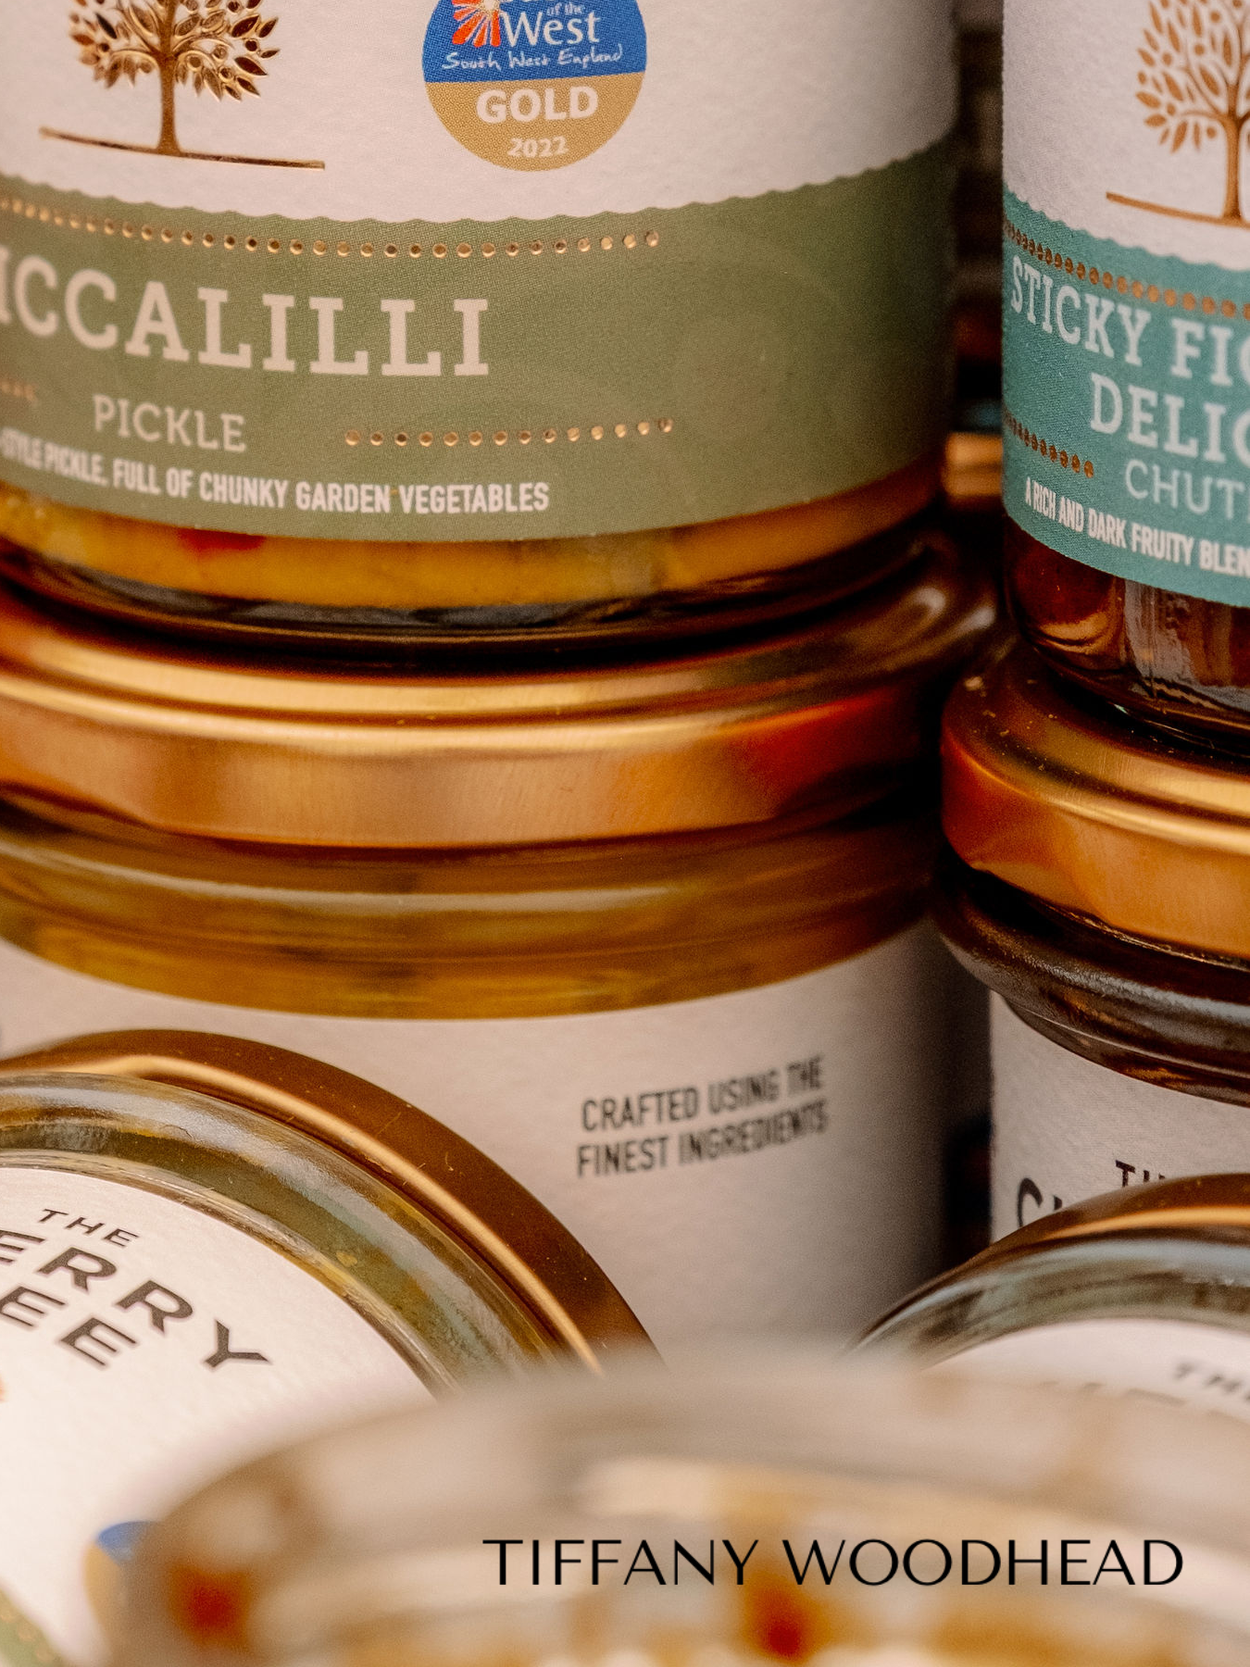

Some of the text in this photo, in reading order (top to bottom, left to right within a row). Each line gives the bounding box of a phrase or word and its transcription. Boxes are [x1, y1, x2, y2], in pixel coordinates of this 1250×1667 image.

[499, 10, 601, 48] West
[546, 1, 586, 17] of the
[441, 43, 624, 70] South West England
[475, 85, 600, 124] GOLD
[507, 135, 570, 159] 2022
[1010, 254, 1152, 368] STICKY
[92, 393, 249, 454] PICKLE
[112, 458, 162, 497] FULL
[166, 466, 194, 499] OF
[198, 470, 289, 511] CHUNKY
[295, 479, 391, 515] GARDEN
[399, 479, 551, 515] VEGETABLES
[1124, 458, 1250, 526] CHUT
[1024, 476, 1033, 507] A
[1032, 479, 1057, 522] RICH
[1058, 496, 1085, 533] AND
[1087, 507, 1127, 549] DARK
[1131, 522, 1196, 566] FRUITY
[581, 1053, 826, 1133] CRAFTED USING THE
[577, 1097, 830, 1179] FINEST INGREDIENTS
[36, 1208, 141, 1248] THE
